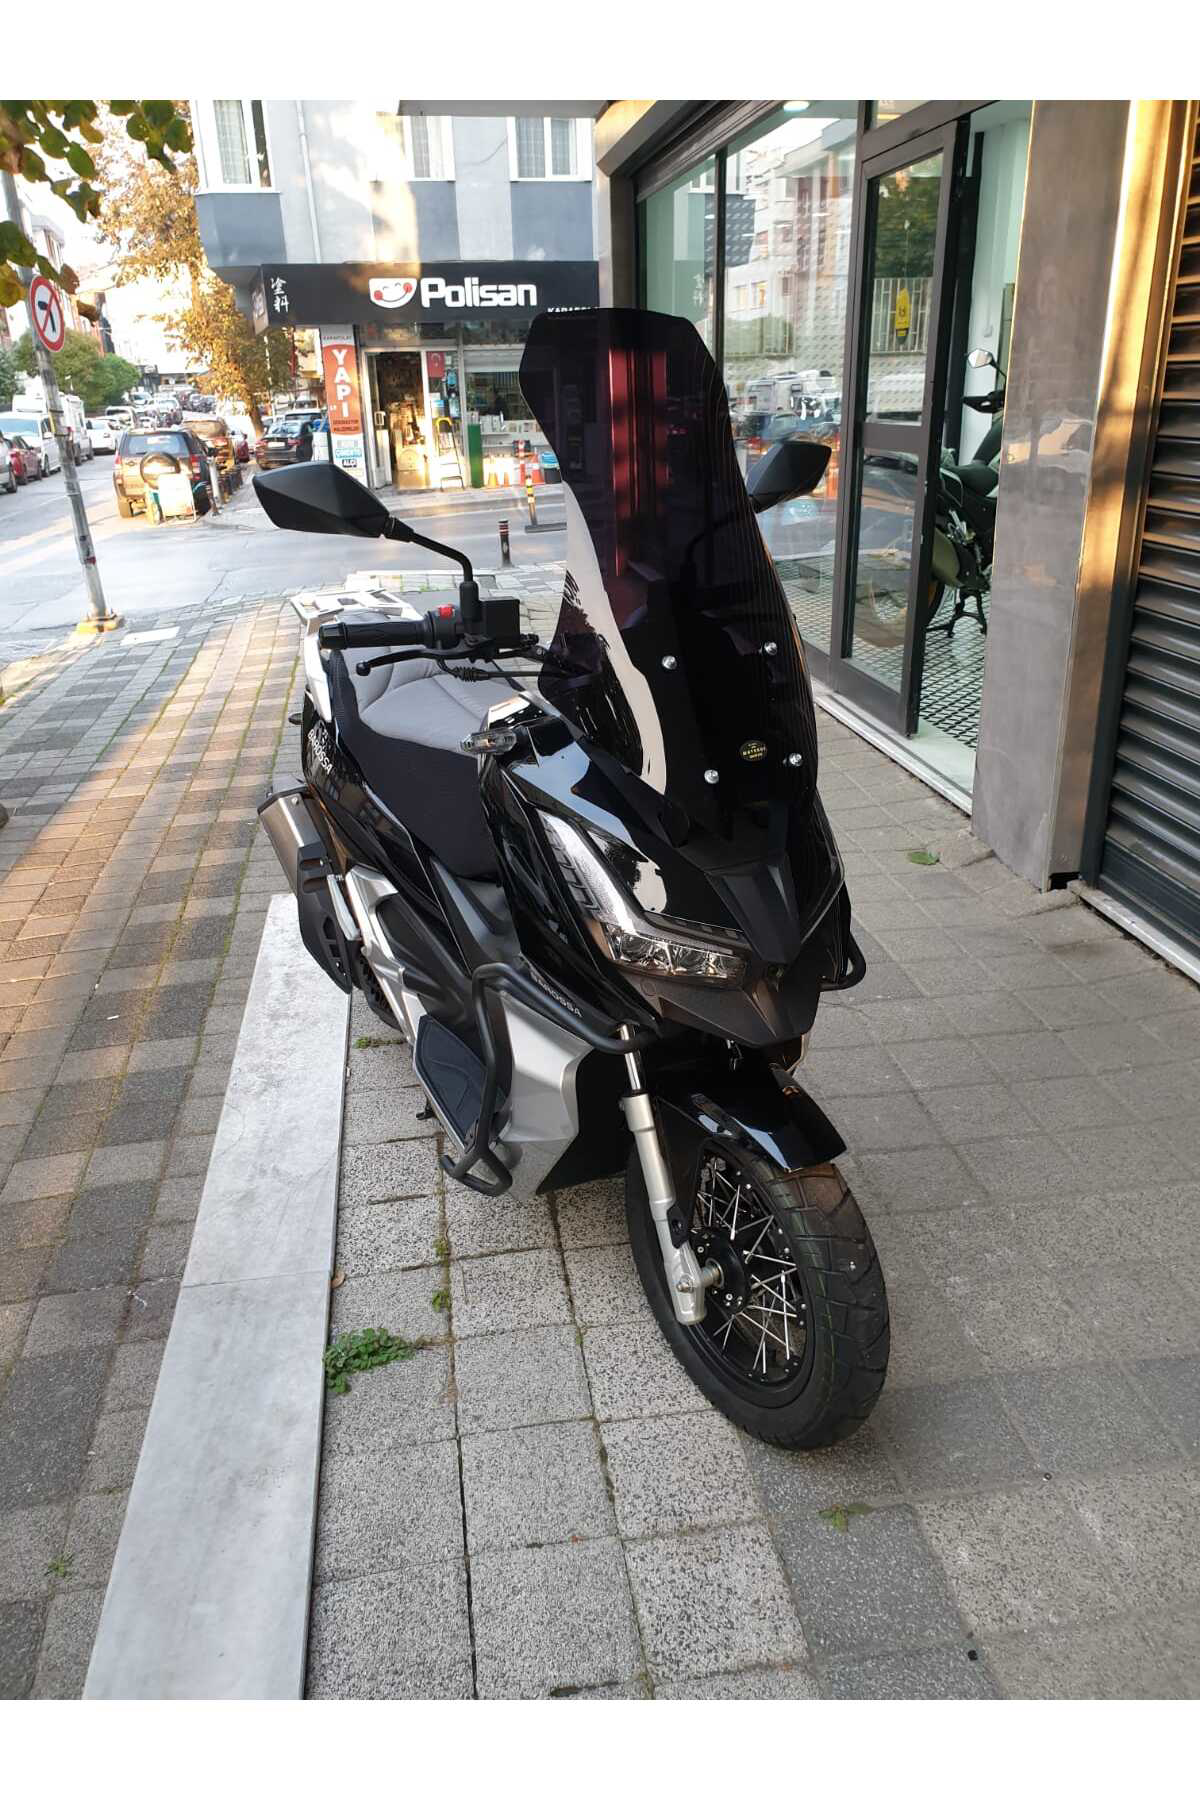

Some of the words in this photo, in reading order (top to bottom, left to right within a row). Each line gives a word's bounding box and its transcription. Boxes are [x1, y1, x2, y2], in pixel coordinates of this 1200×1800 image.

[420, 277, 538, 308] Polisan
[332, 348, 352, 418] YAPI
[307, 728, 333, 775] BAROSSA
